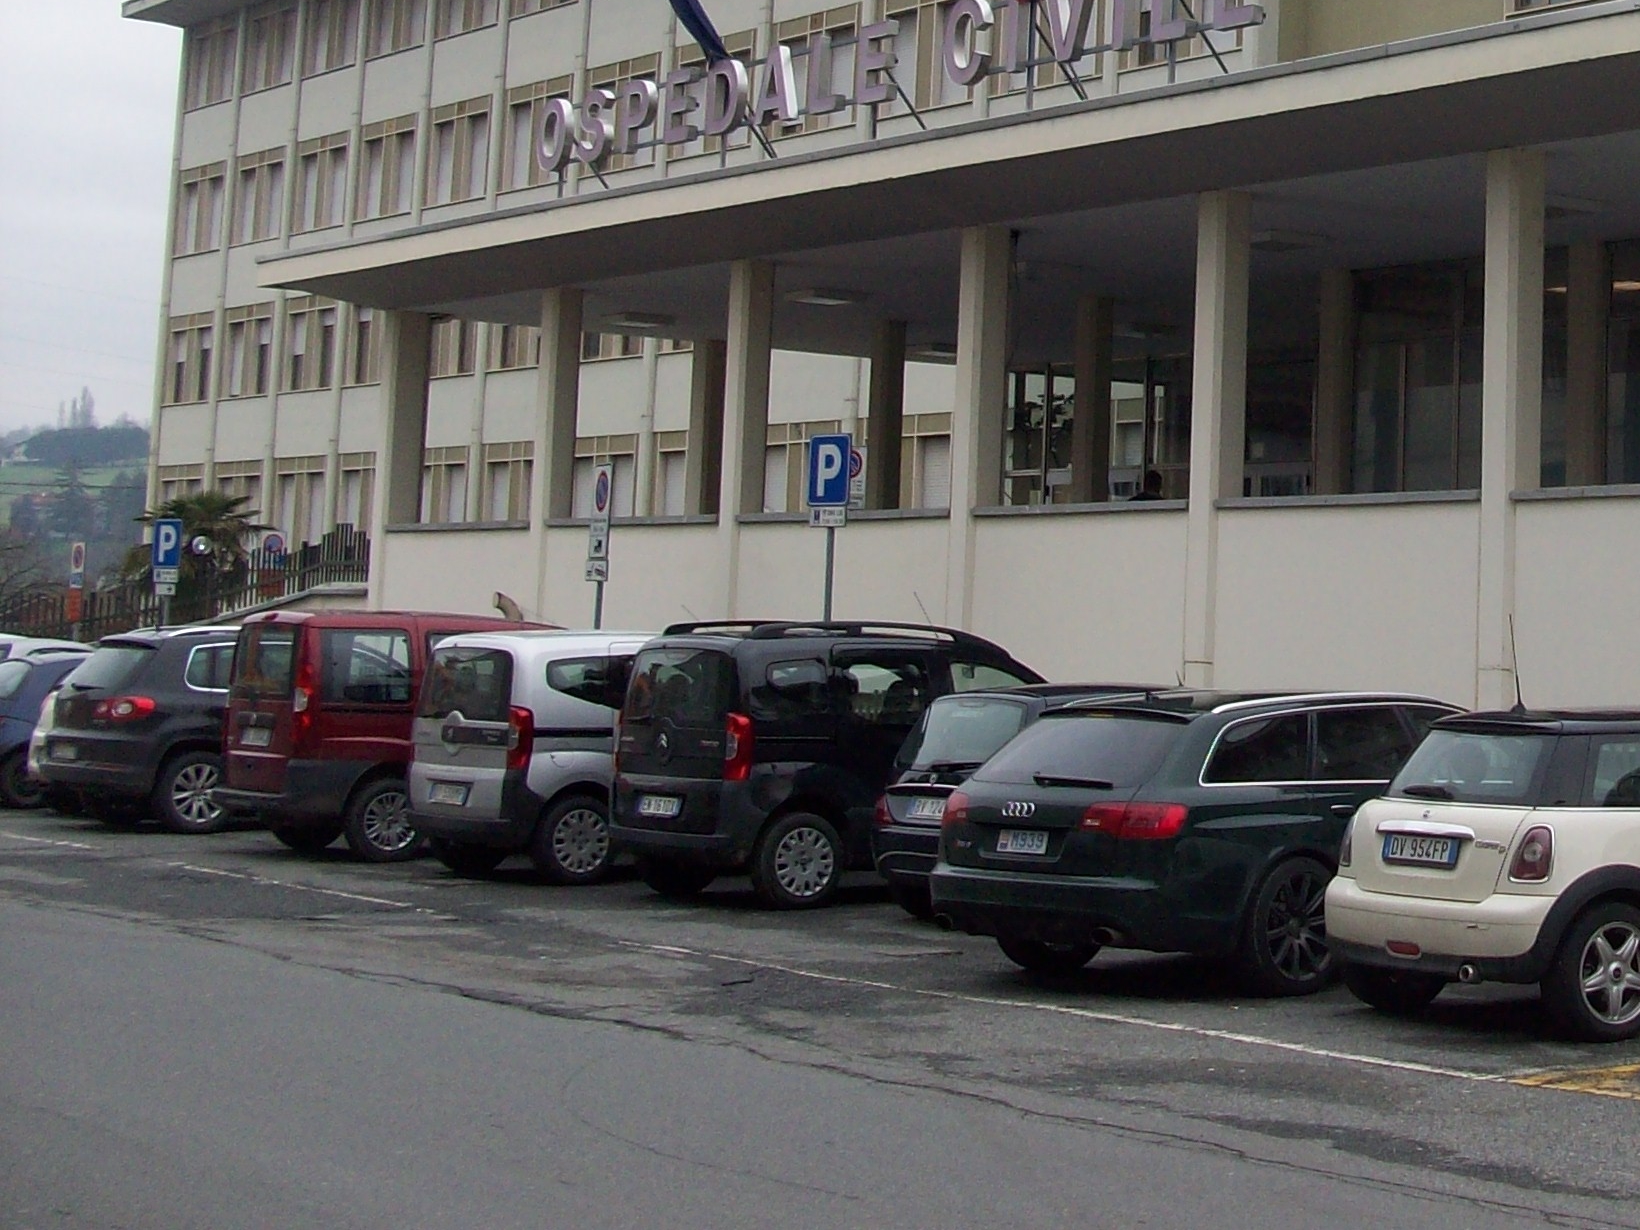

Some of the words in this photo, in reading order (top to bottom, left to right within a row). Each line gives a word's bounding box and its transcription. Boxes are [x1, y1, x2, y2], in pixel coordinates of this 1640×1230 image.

[536, 20, 900, 172] OSPEDALE
[816, 444, 842, 497] P
[158, 525, 177, 562] P
[1390, 836, 1407, 856] DV
[1410, 838, 1450, 861] 954FP
